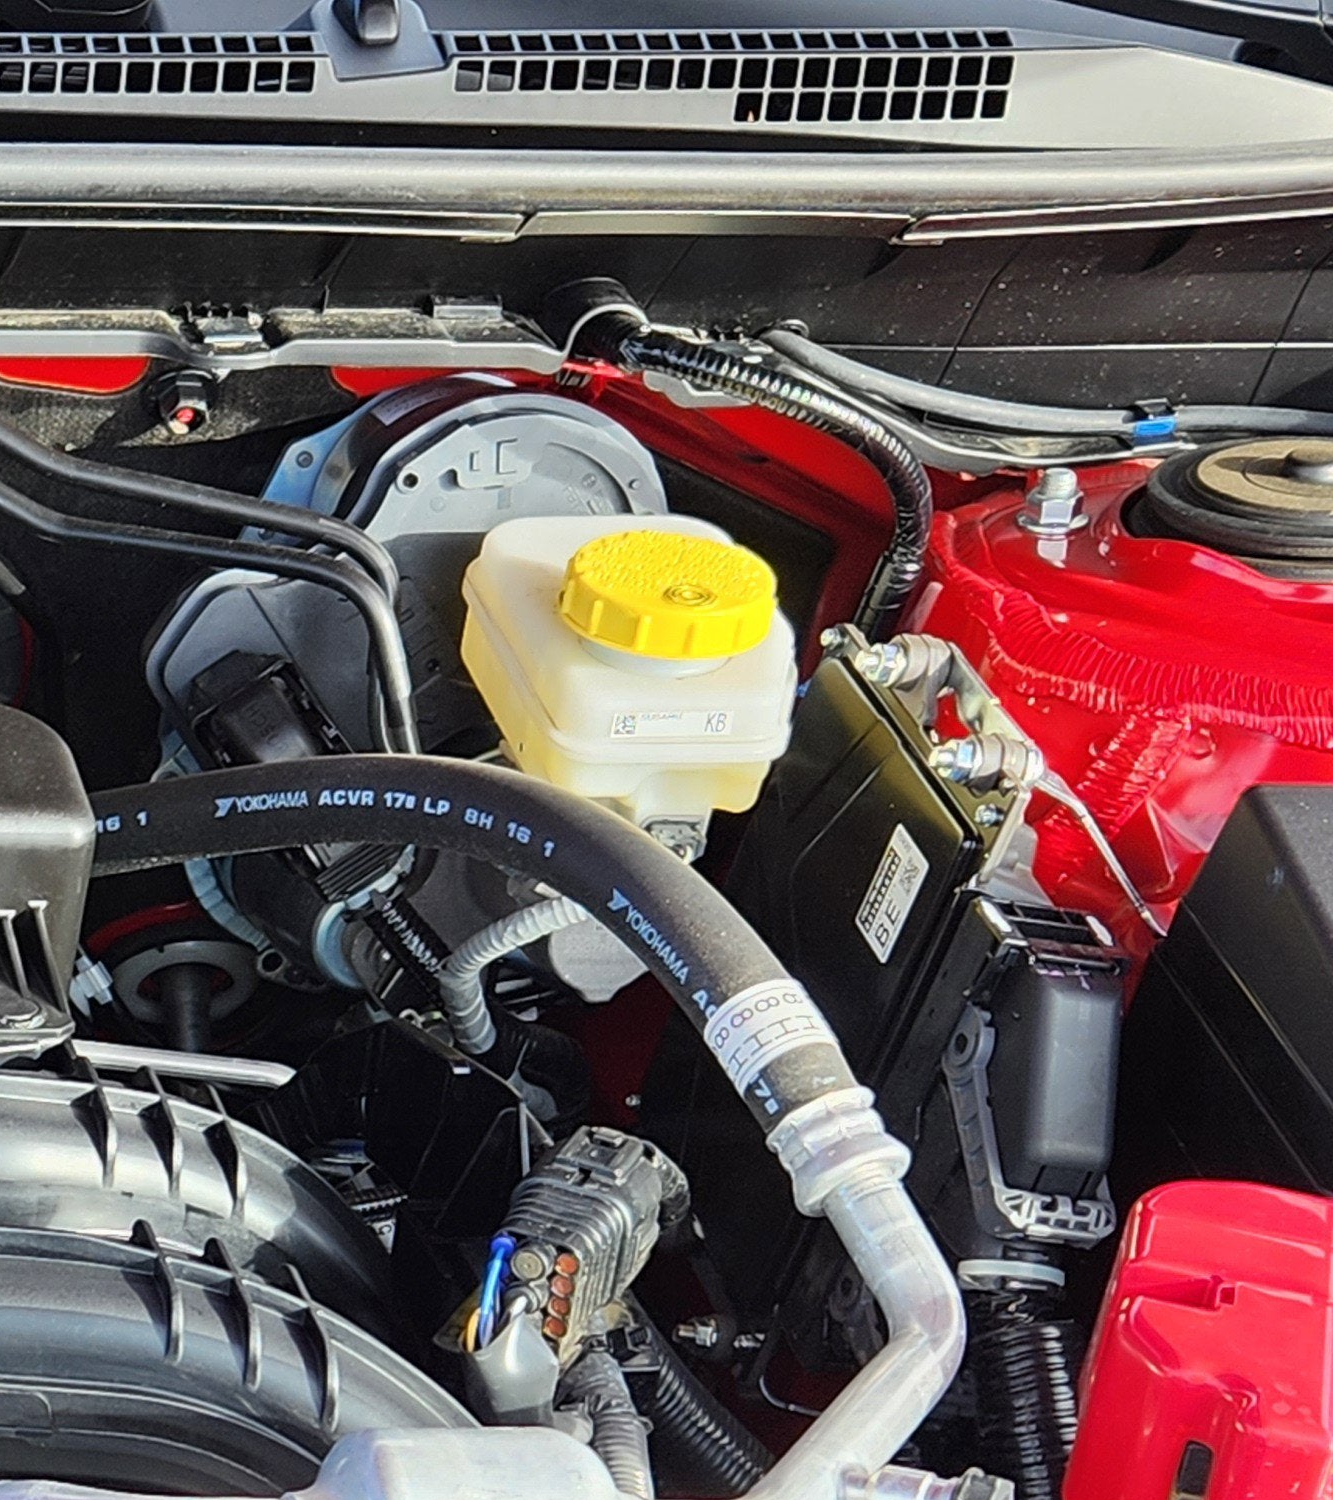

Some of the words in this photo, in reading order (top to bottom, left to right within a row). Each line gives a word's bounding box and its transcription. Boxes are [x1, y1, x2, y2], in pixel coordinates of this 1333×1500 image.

[703, 712, 728, 733] KB
[235, 790, 309, 814] YOKOHAMA
[317, 789, 375, 807] ACVR
[422, 797, 451, 816] LP
[623, 904, 692, 986] YOKOHAMA
